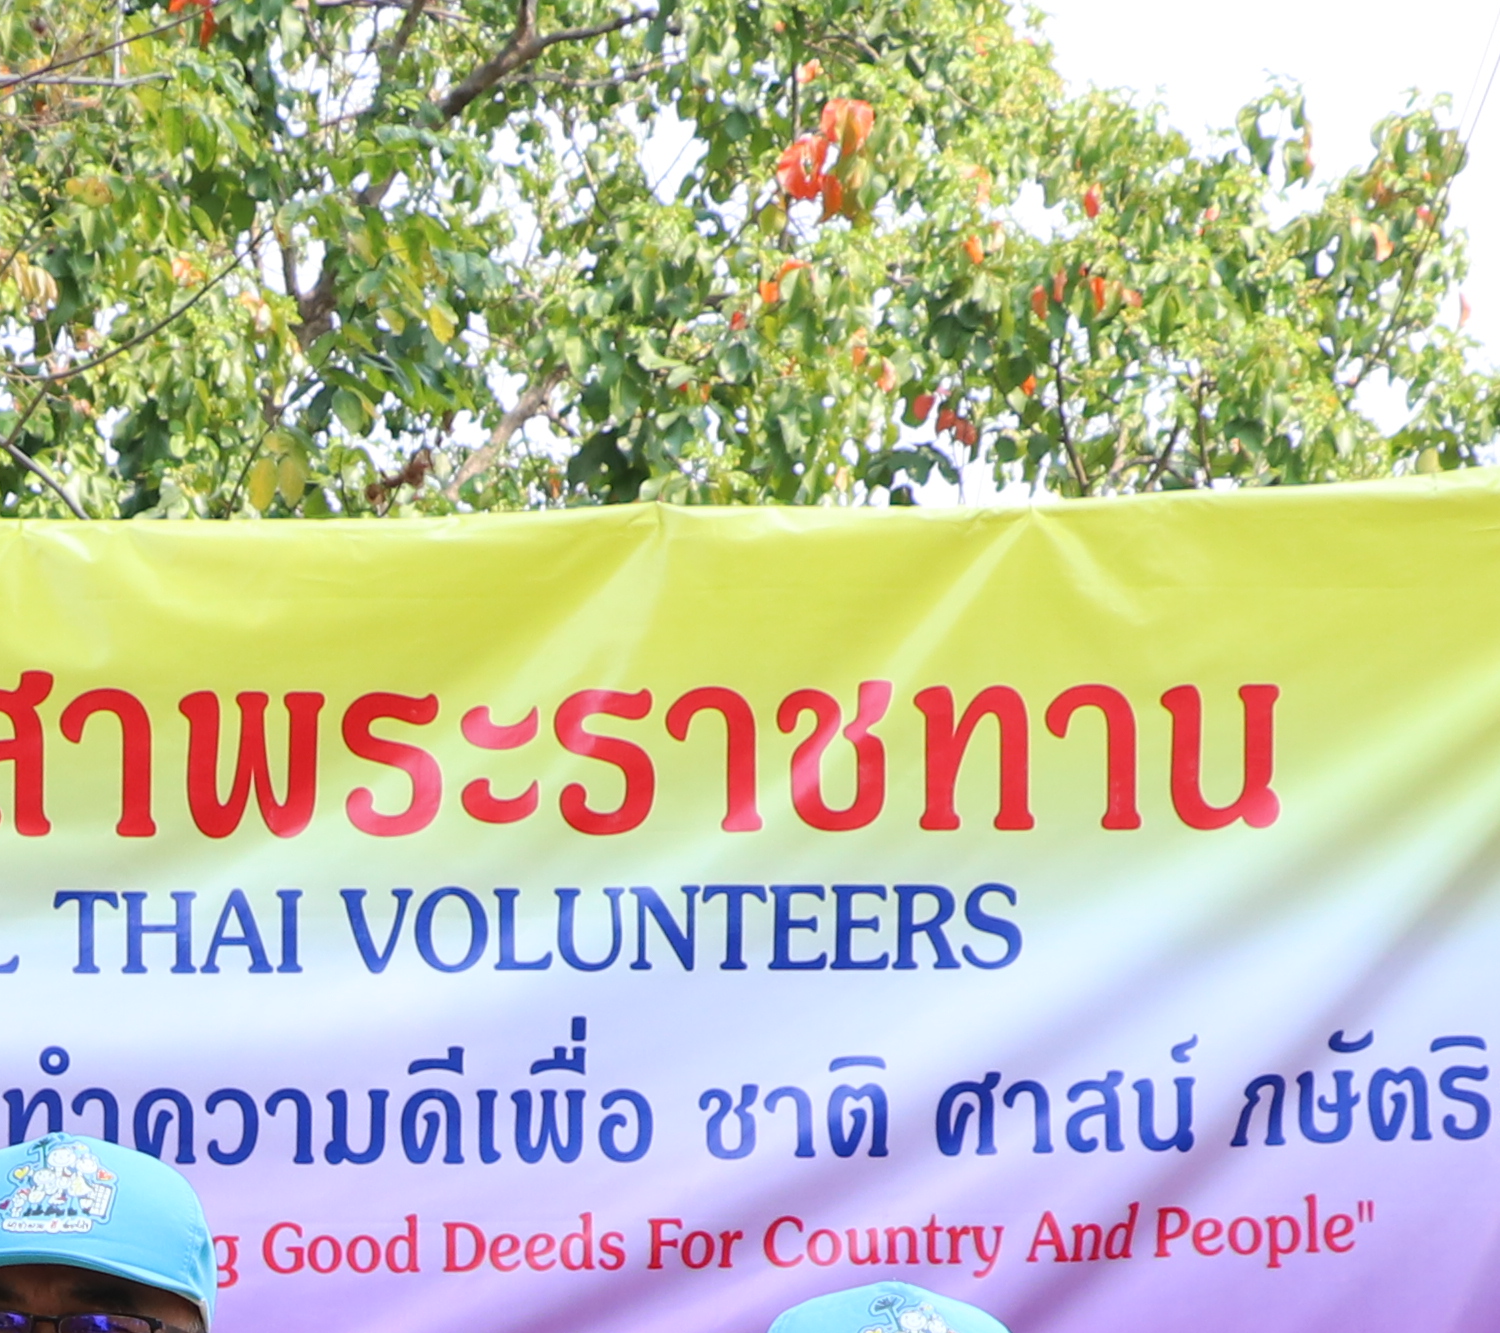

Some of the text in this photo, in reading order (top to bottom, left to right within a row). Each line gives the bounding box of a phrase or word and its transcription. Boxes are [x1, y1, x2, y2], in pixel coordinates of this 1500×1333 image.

[53, 888, 304, 975] THAI
[338, 881, 1024, 974] VOLUNTEERS
[697, 1054, 889, 1160] ชาติ
[936, 1033, 1198, 1157] ศาสน์
[262, 1214, 421, 1275] Good
[443, 1211, 626, 1274] Deeds
[646, 1216, 744, 1271] For
[764, 1213, 1003, 1279] Country
[1026, 1200, 1140, 1264] And
[1154, 1193, 1376, 1269] People"
